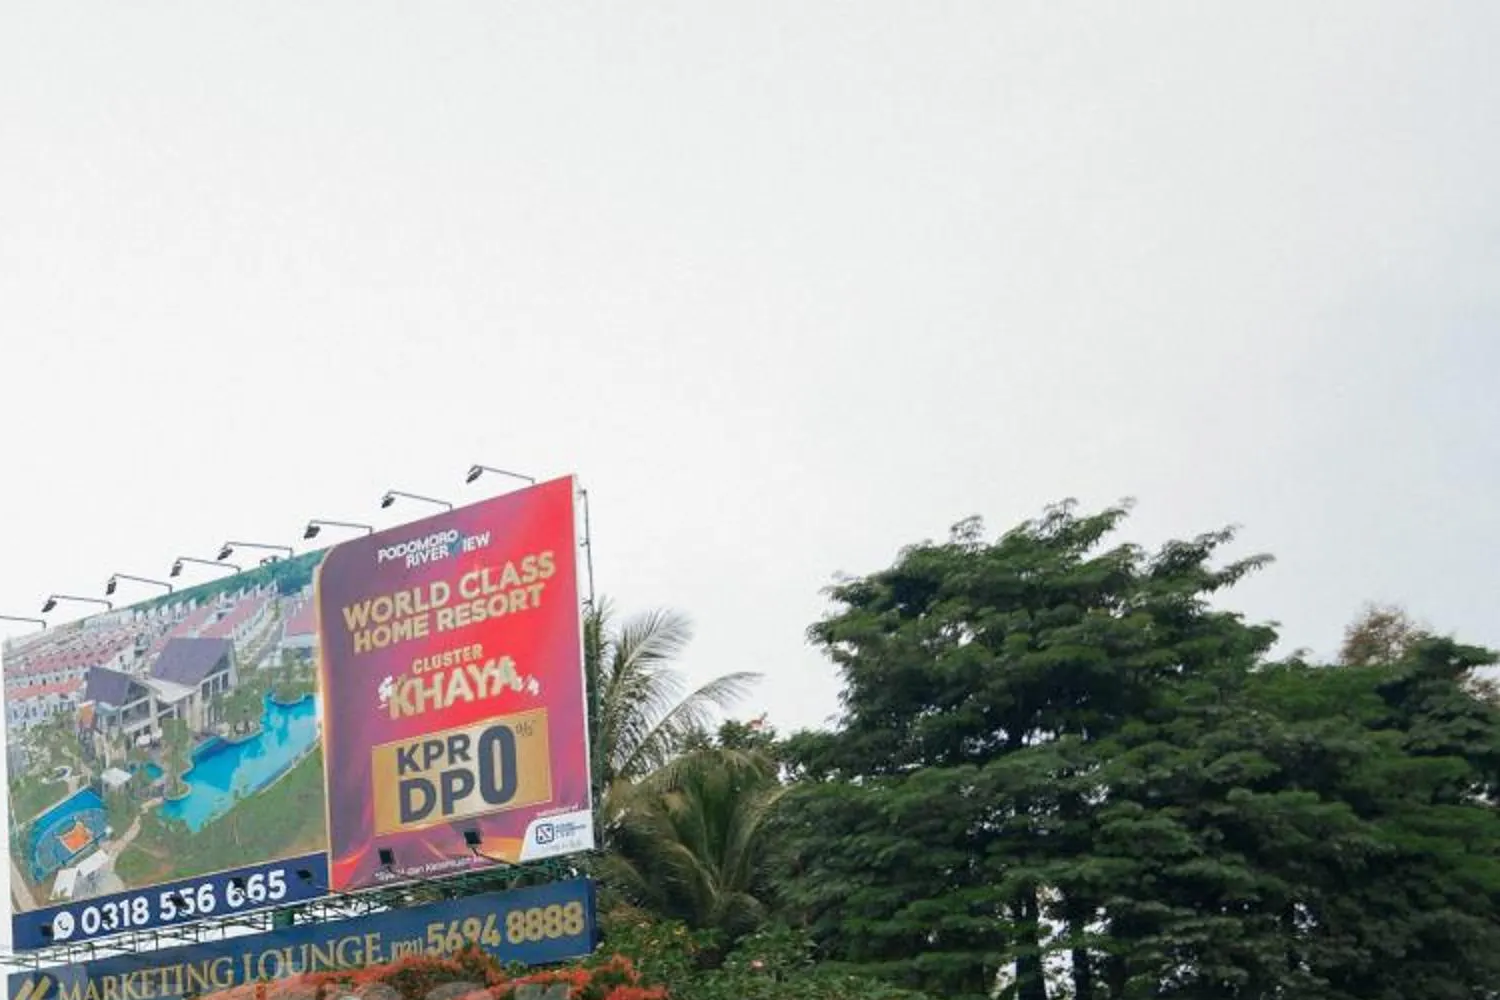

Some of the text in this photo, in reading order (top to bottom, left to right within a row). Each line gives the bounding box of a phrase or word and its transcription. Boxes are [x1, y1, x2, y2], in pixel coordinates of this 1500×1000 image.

[377, 528, 460, 564] PODOMORO
[406, 545, 449, 568] RIVER
[342, 550, 556, 632] WORLD CLASS
[353, 582, 546, 654] HOME RESORT
[411, 643, 484, 675] CLUSTER
[387, 655, 518, 719] KHAYA
[396, 733, 473, 777] KPR
[398, 767, 476, 824] DP
[79, 896, 149, 937] 0318
[243, 931, 383, 988] LOUNGE
[426, 912, 501, 956] 5694
[506, 900, 585, 945] 8888
